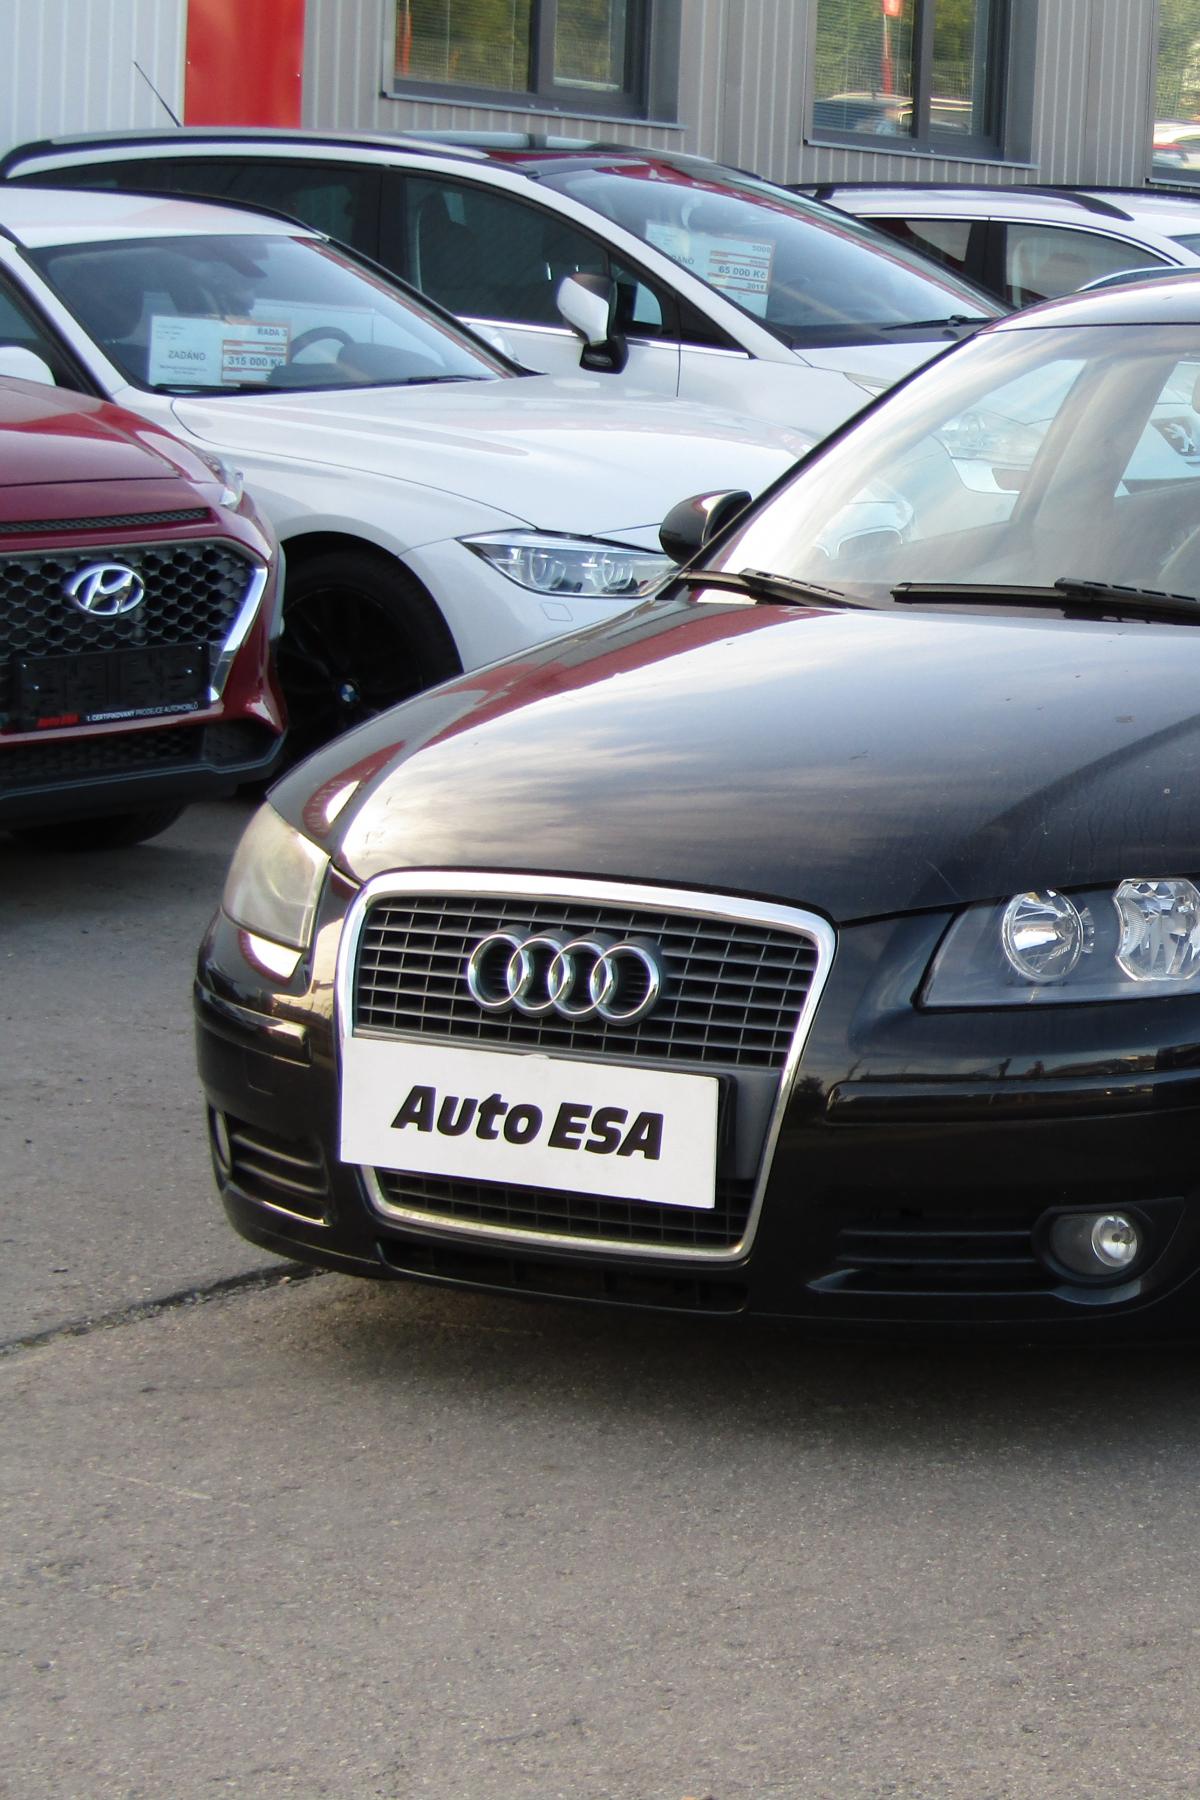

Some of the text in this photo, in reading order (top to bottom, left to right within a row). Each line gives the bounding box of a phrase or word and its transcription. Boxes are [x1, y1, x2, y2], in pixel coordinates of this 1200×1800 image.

[718, 266, 730, 274] 65
[732, 267, 750, 277] 000
[228, 356, 246, 366] 315
[250, 357, 268, 367] 000
[391, 1084, 664, 1161] Auto ESA
